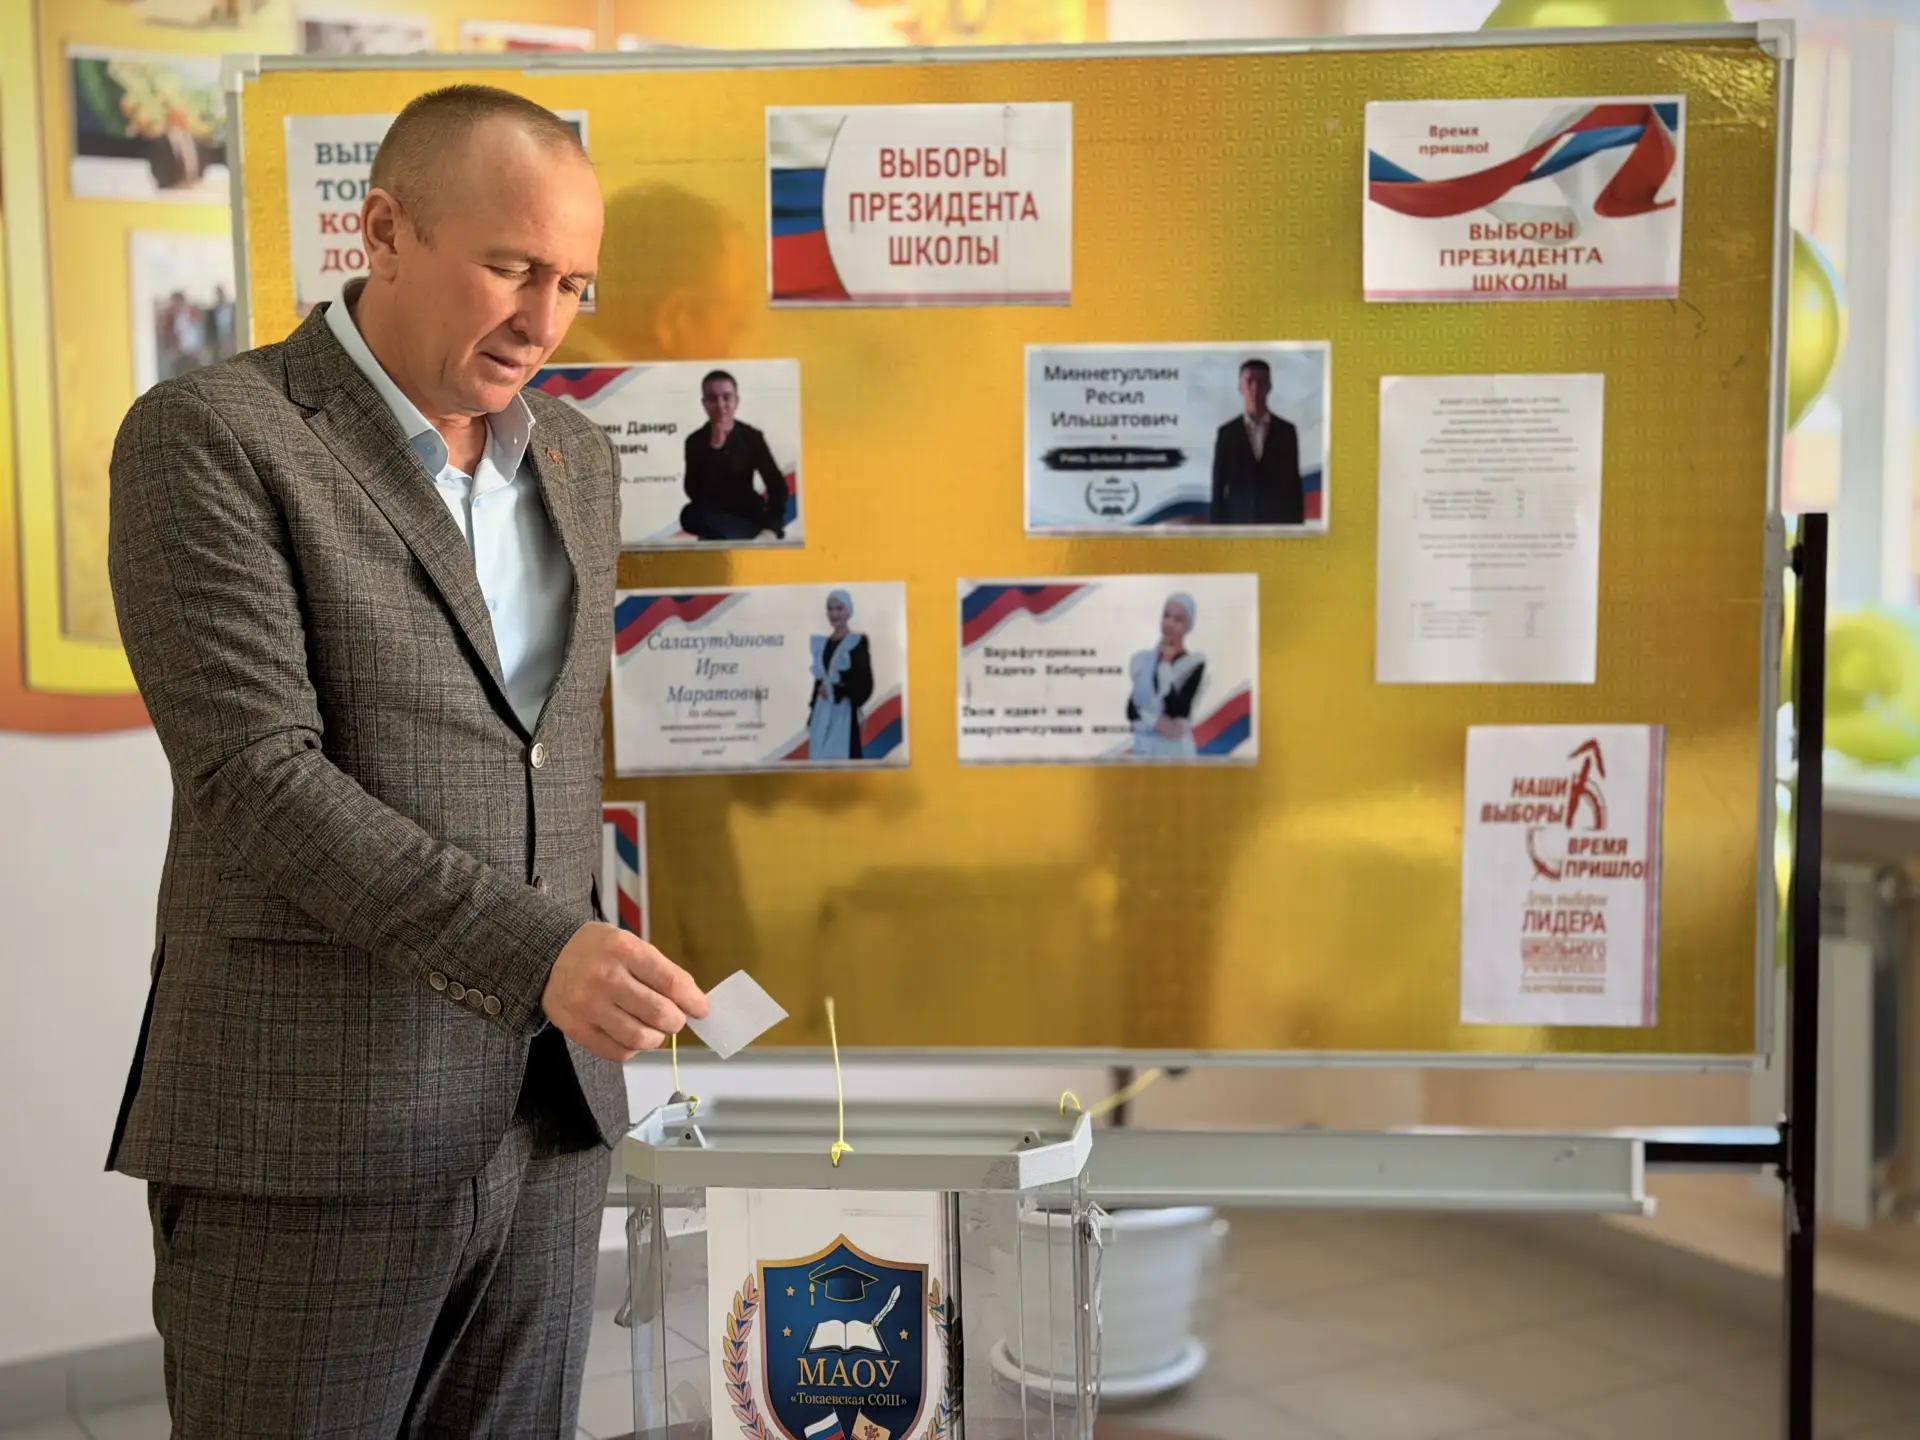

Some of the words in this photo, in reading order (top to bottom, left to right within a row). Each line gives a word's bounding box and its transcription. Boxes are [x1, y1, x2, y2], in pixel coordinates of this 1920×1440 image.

[1429, 125, 1479, 139] Время
[1419, 142, 1489, 156] пришло!
[879, 147, 1006, 179] ВЫБОРЫ
[849, 191, 1039, 227] ПРЕЗИДЕНТА
[1469, 222, 1574, 240] ВЫБОРЫ
[889, 235, 998, 266] ШКОЛЫ
[1439, 247, 1603, 268] ПРЕЗИДЕНТА
[1472, 273, 1567, 291] ШКОЛЫ
[1044, 365, 1179, 385] Миннетуллин
[1085, 388, 1145, 404] Ресил
[626, 420, 677, 436] Данир
[1051, 412, 1178, 427] Ильшатович
[647, 631, 785, 653] Салахутдинова
[696, 657, 739, 680] Ирке
[666, 685, 769, 706] Маратовна
[1511, 777, 1568, 798] НАШИ
[1480, 803, 1565, 823] ВЫБОРЫ
[1568, 837, 1628, 855] ВРЕМЯ
[1522, 909, 1607, 936] ЛИДЕРА
[797, 1358, 900, 1388] МАОУ
[790, 1392, 865, 1405] «Токаевская
[868, 1393, 907, 1406] СОШ»
